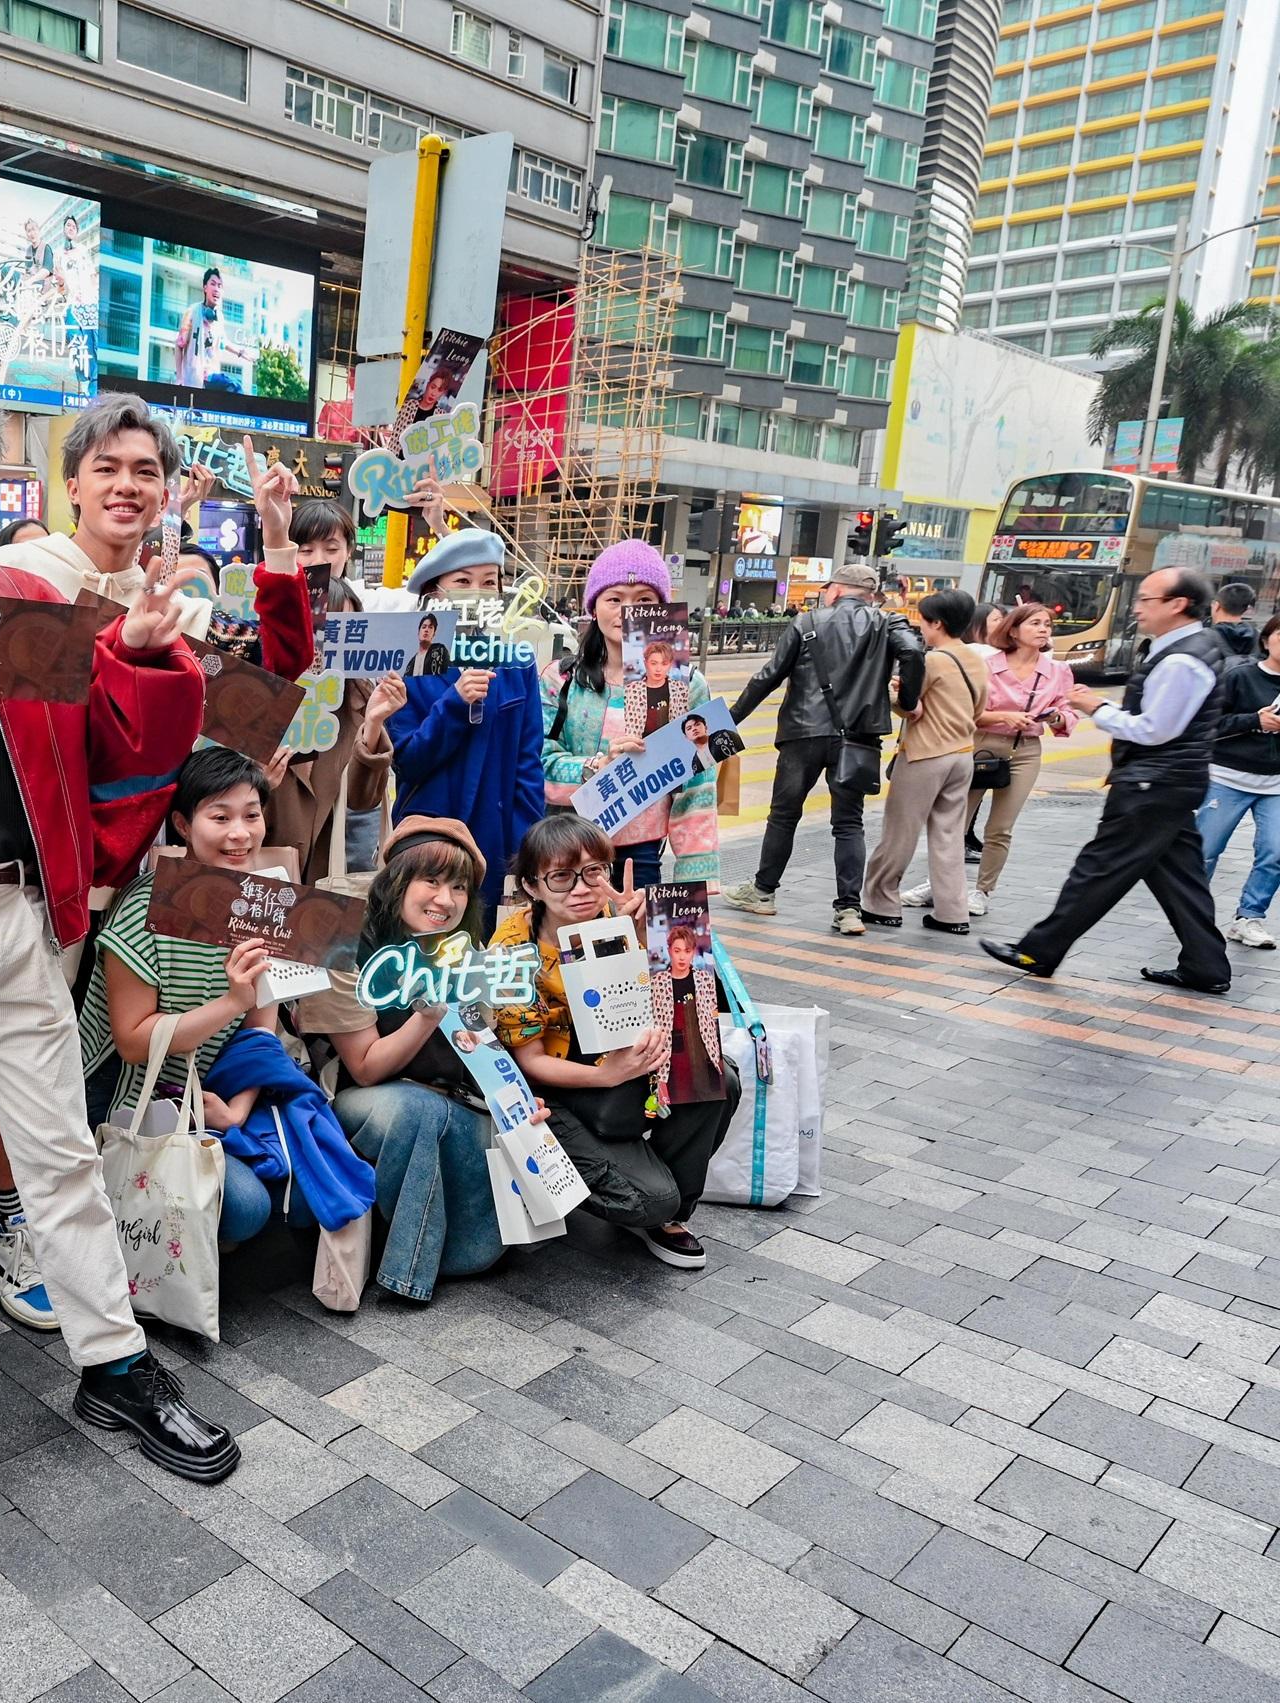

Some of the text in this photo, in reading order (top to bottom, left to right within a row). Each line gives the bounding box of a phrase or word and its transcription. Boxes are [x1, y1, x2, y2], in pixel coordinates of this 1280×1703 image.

[438, 329, 468, 346] Ritchie
[445, 348, 471, 367] Leong
[1077, 542, 1093, 559] 2
[624, 605, 669, 619] Ritchie
[649, 620, 685, 635] Leong
[449, 631, 534, 663] itchie
[343, 649, 405, 671] WONG
[627, 757, 686, 806] WONG
[649, 885, 689, 902] Ritchie
[672, 903, 705, 919] Leong
[228, 916, 293, 939] Ritchie & Chit
